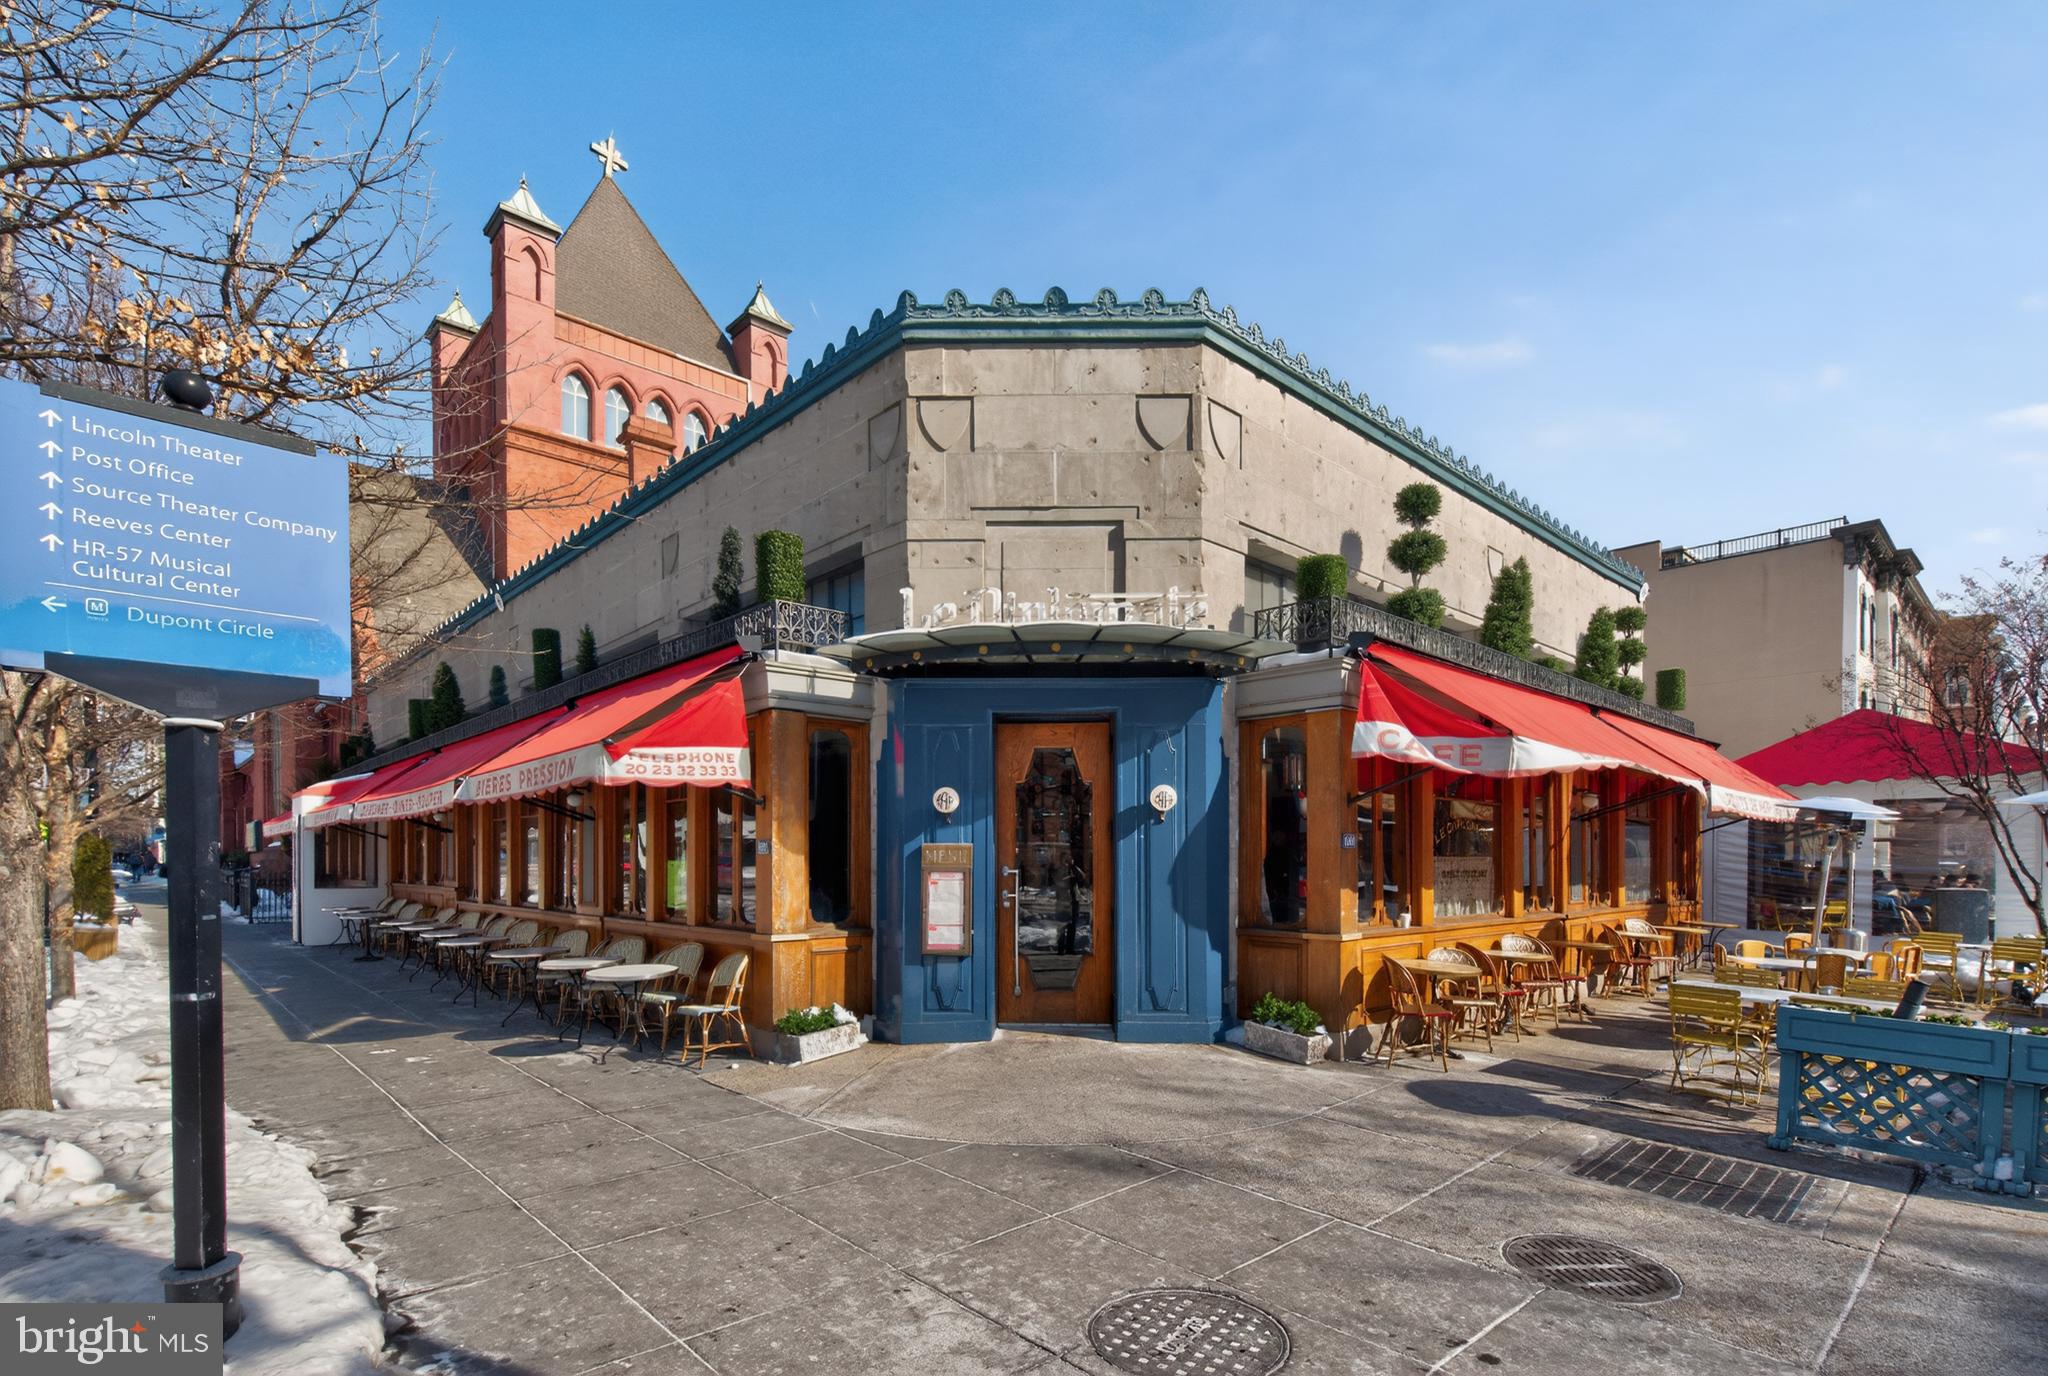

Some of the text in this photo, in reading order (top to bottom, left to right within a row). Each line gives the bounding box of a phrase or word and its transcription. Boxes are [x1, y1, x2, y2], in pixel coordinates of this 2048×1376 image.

[71, 416, 244, 467] Lincoln Theater
[71, 447, 194, 486] Post Office
[71, 476, 338, 544] Source Theater Company
[72, 507, 232, 549] Reeves Center
[72, 538, 232, 578] HR-57 Musical
[72, 560, 241, 599] Cultural Center
[127, 606, 212, 632] Dupont
[218, 618, 274, 640] Circle
[519, 756, 577, 790] PRESSION
[625, 764, 648, 774] 20
